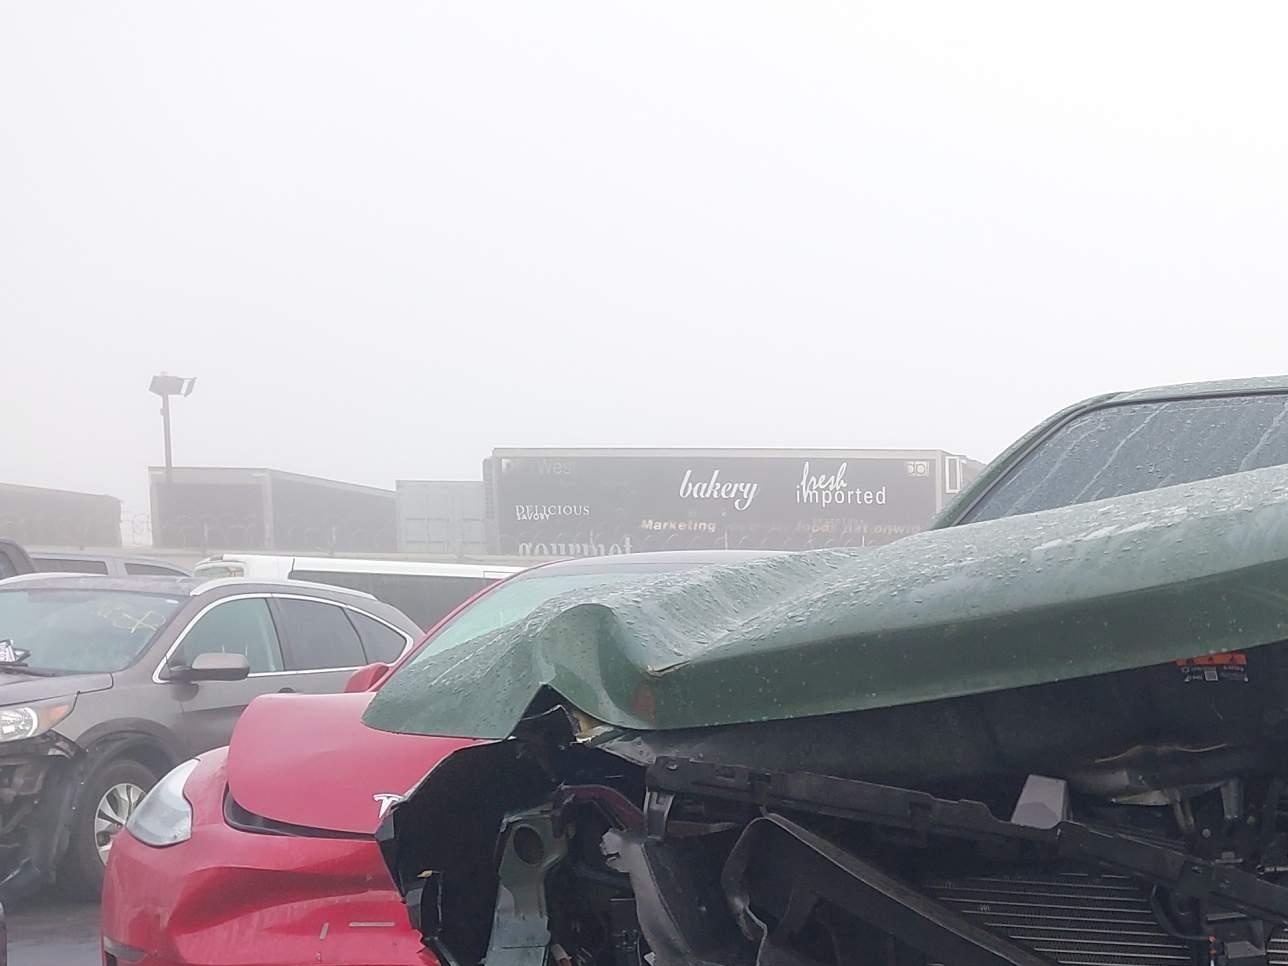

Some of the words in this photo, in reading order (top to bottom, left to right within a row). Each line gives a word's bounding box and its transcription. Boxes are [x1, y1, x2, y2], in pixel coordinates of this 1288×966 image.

[679, 469, 758, 511] bakery
[800, 461, 848, 498] fresh
[515, 504, 591, 516] DELICIOUS
[796, 485, 887, 508] imported
